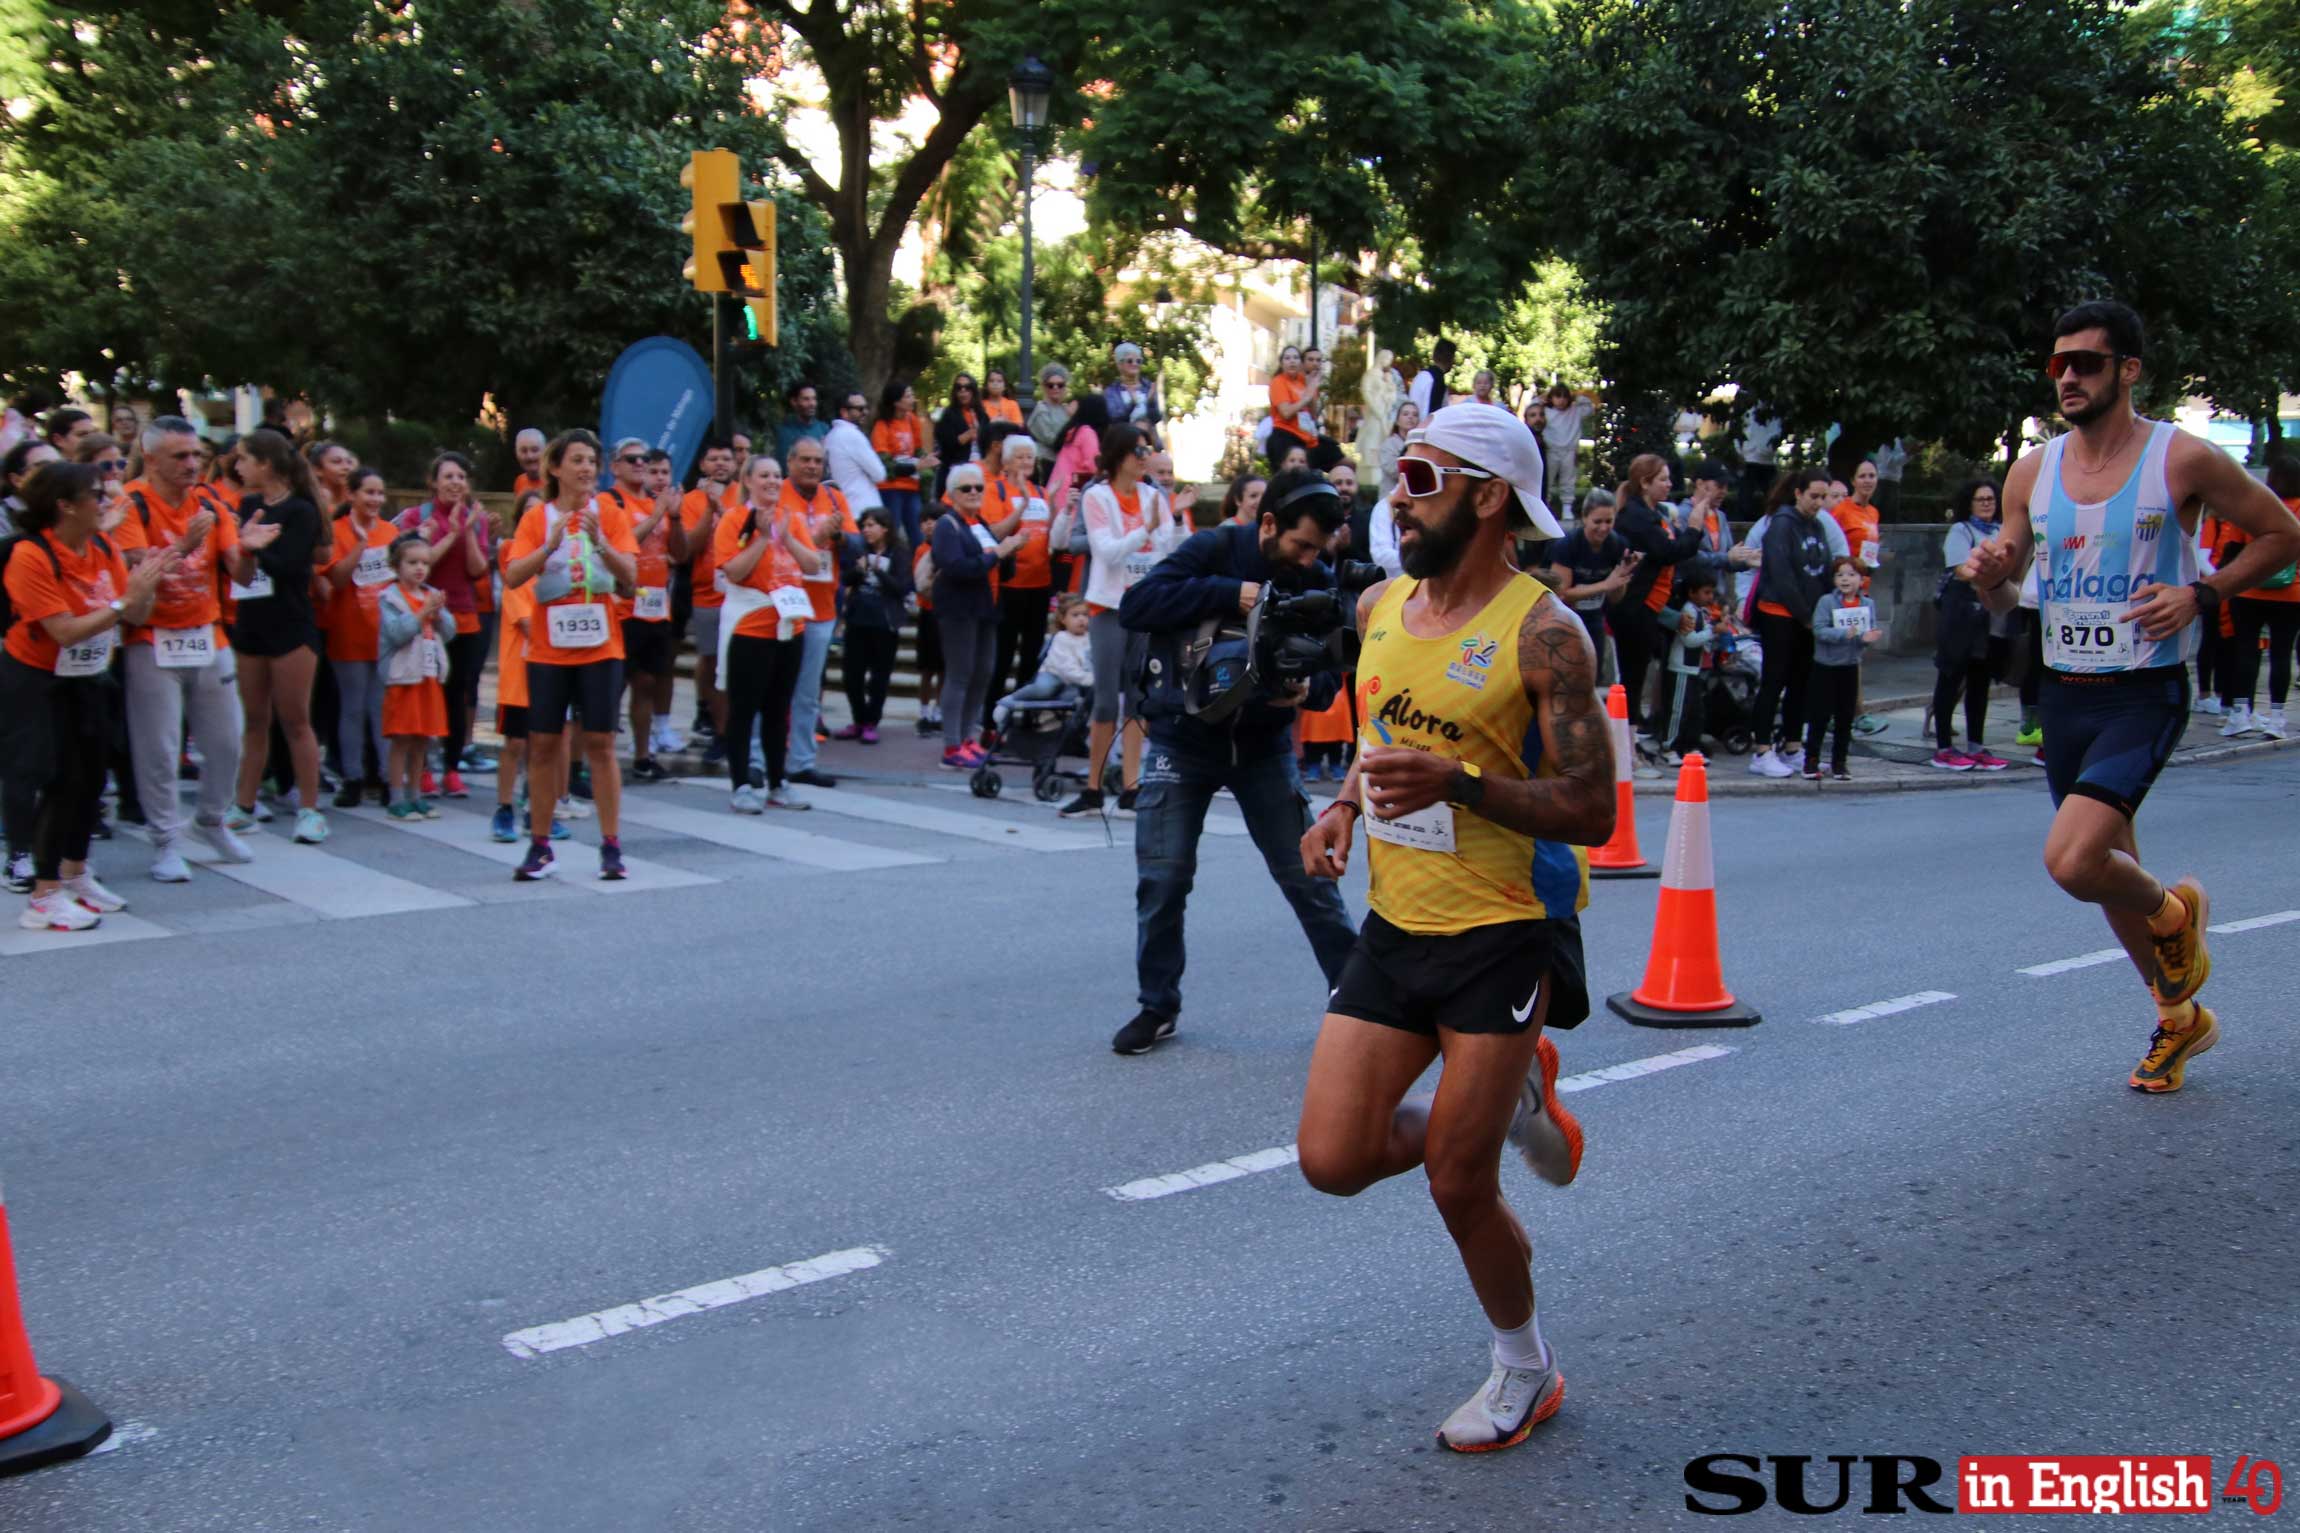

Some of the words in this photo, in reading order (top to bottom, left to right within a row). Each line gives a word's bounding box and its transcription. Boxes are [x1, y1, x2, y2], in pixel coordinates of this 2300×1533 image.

[556, 619, 601, 632] 1933
[2061, 625, 2115, 647] 870
[162, 639, 208, 651] 1748
[1379, 688, 1464, 742] Álora
